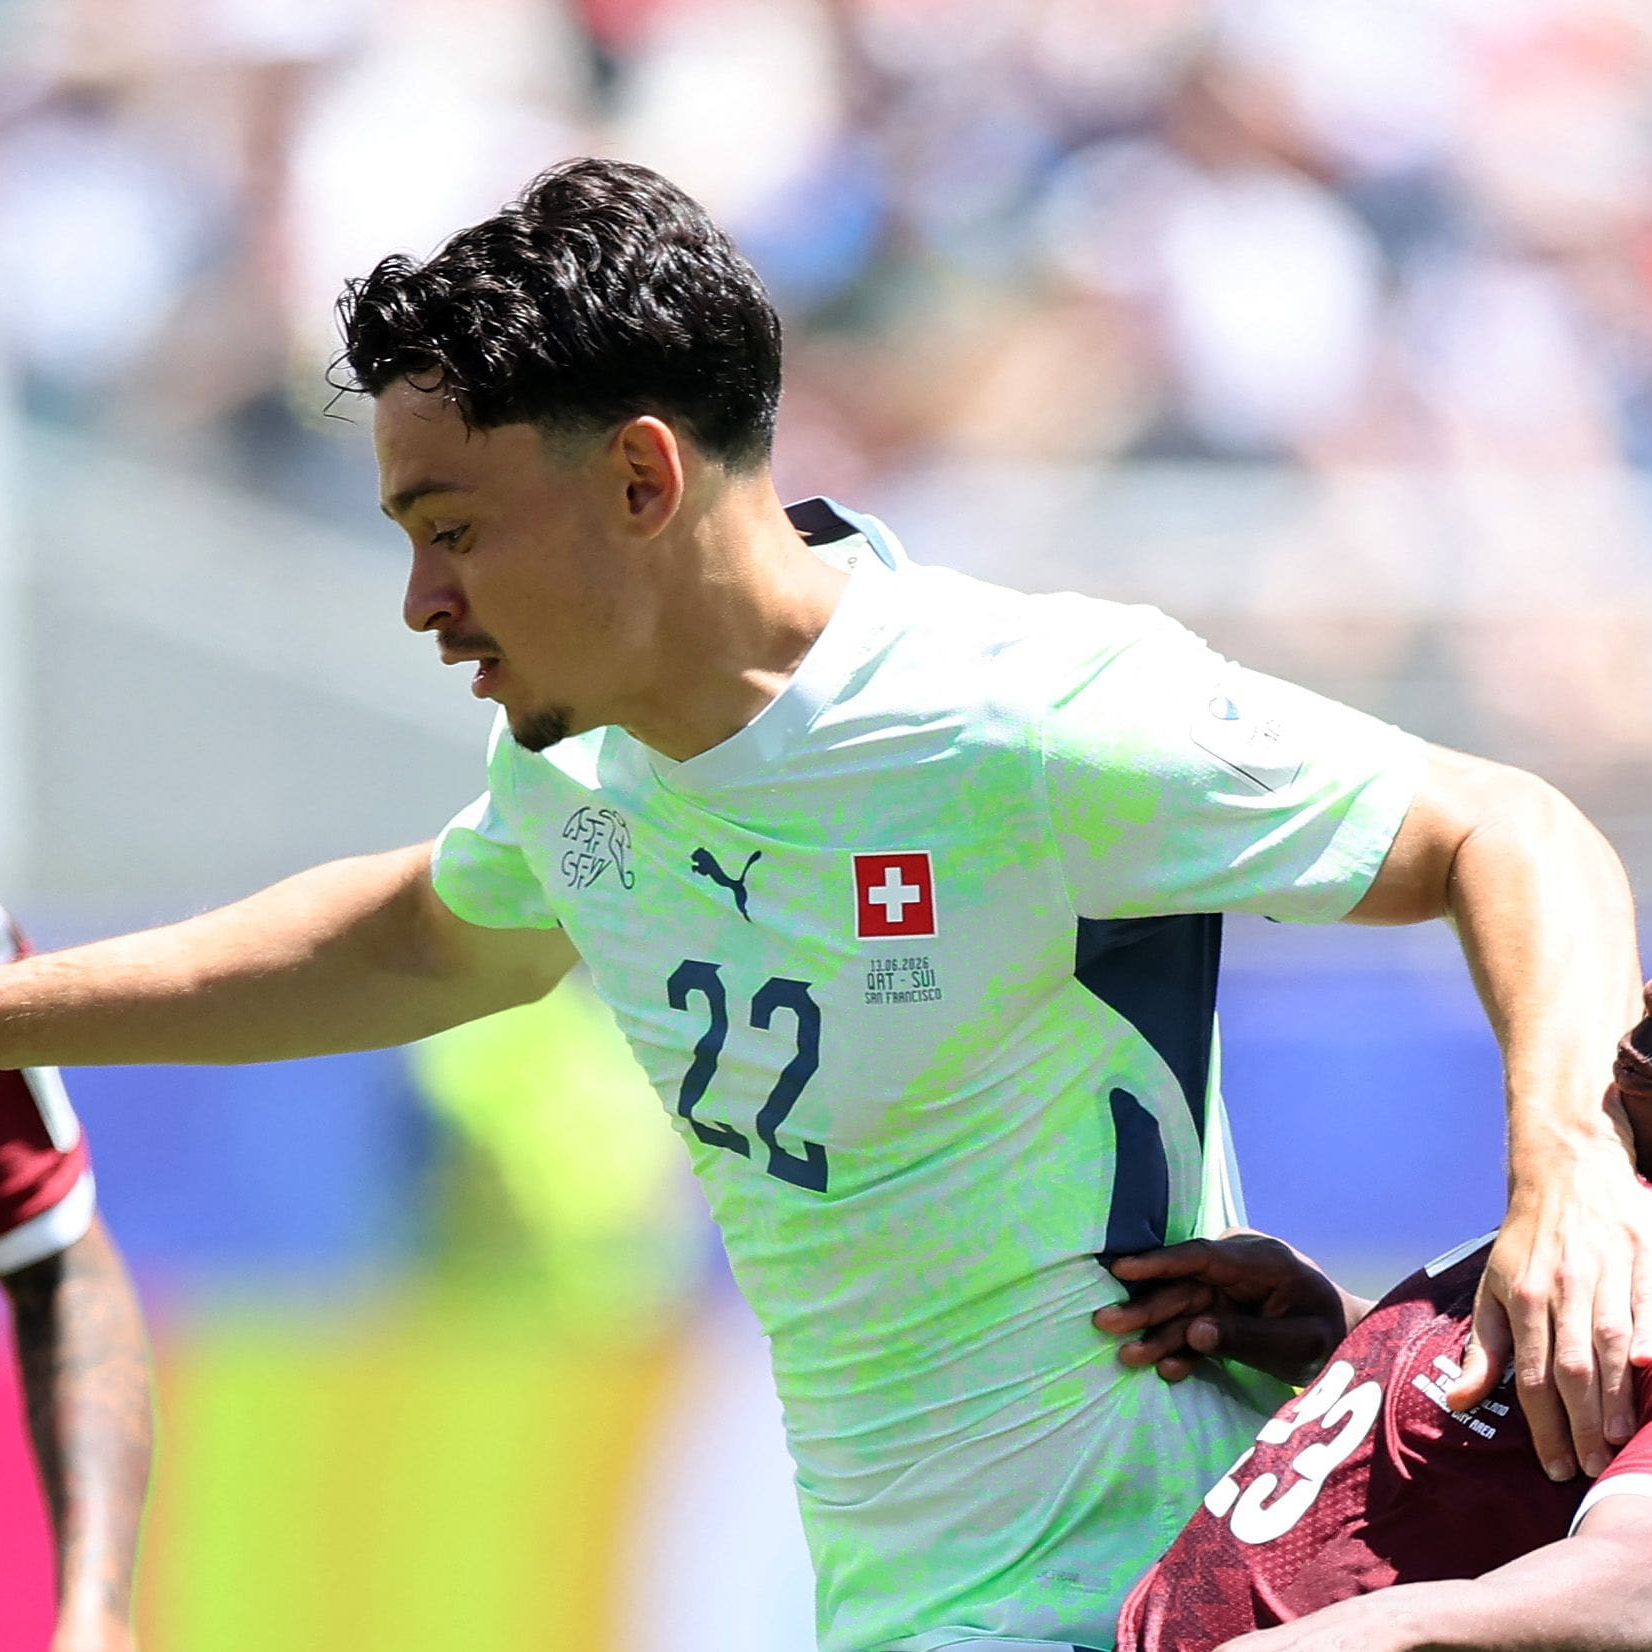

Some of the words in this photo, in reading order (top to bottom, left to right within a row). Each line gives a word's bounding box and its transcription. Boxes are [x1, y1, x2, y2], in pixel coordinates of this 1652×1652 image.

[870, 957, 929, 972] 13.06.2026
[867, 972, 894, 990] QAT
[911, 969, 936, 988] SUI
[865, 992, 883, 1004] SAN
[886, 988, 942, 1004] FRANCISCO
[666, 959, 829, 1194] 22
[1204, 1360, 1382, 1545] 23
